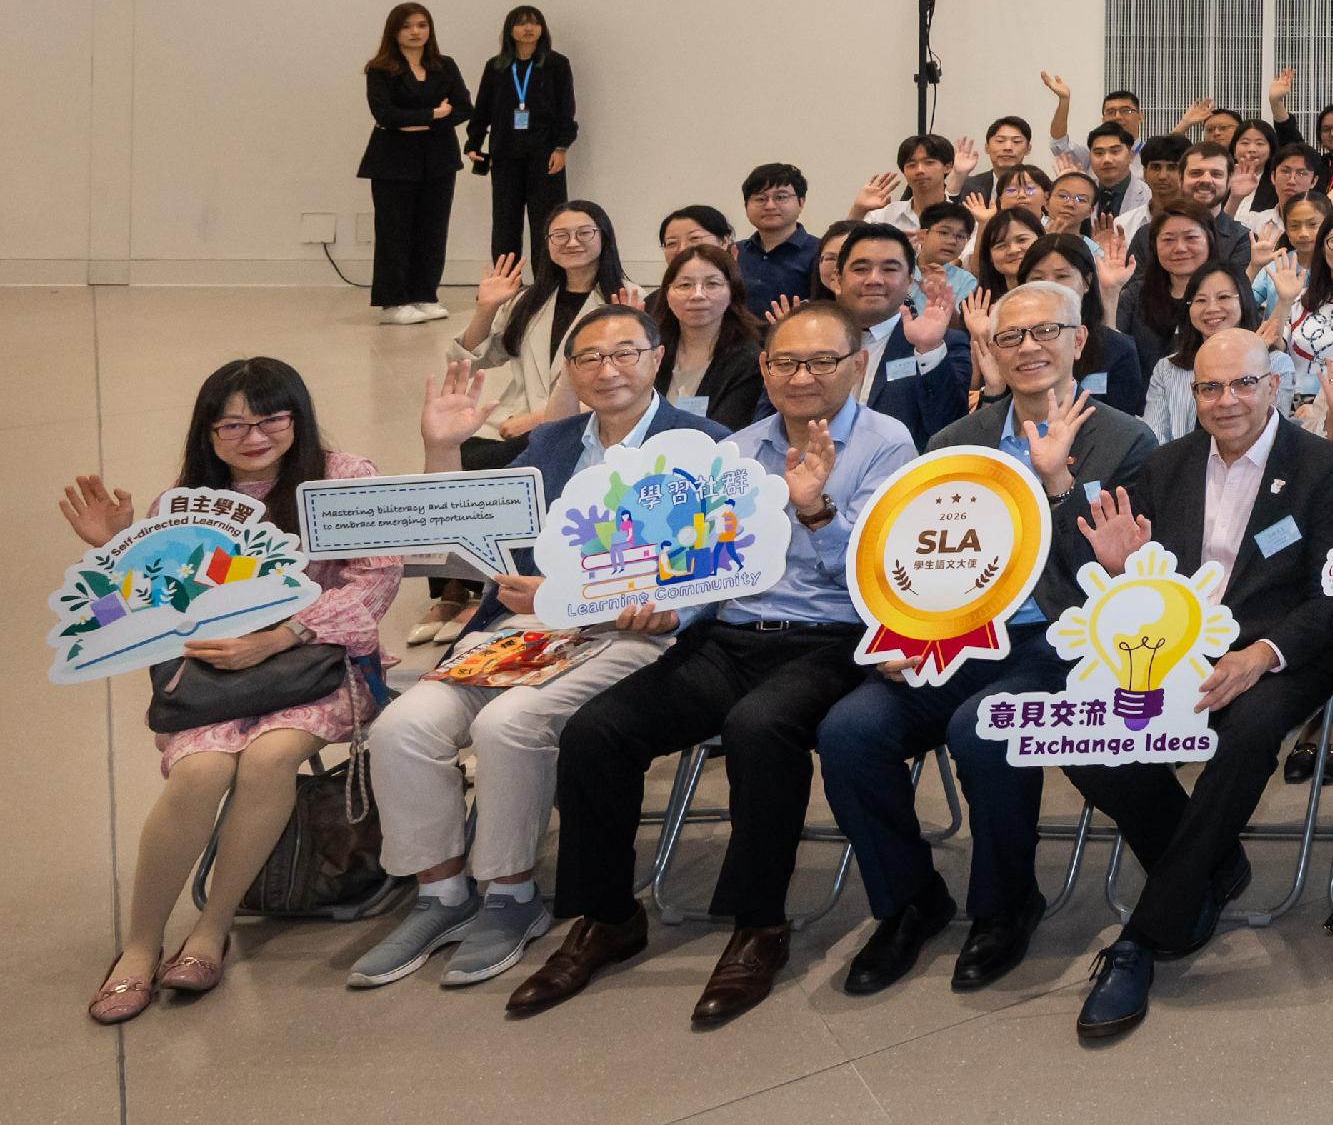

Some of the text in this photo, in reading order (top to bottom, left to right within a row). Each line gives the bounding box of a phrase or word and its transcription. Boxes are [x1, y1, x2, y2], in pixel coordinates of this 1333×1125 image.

[638, 468, 749, 510] 學習社群
[169, 494, 255, 524] 自主學習
[322, 498, 522, 518] Mastering biliteracy and trilingualism
[323, 512, 494, 530] to embrace emerging opportunities
[939, 512, 967, 521] 2026
[110, 515, 242, 557] Self-directed Learning
[916, 528, 981, 555] SLA
[913, 558, 977, 570] 學生語文大使
[567, 570, 762, 617] Learning Community
[988, 699, 1108, 729] 意見交流
[1019, 733, 1211, 757] Exchange Ideas
